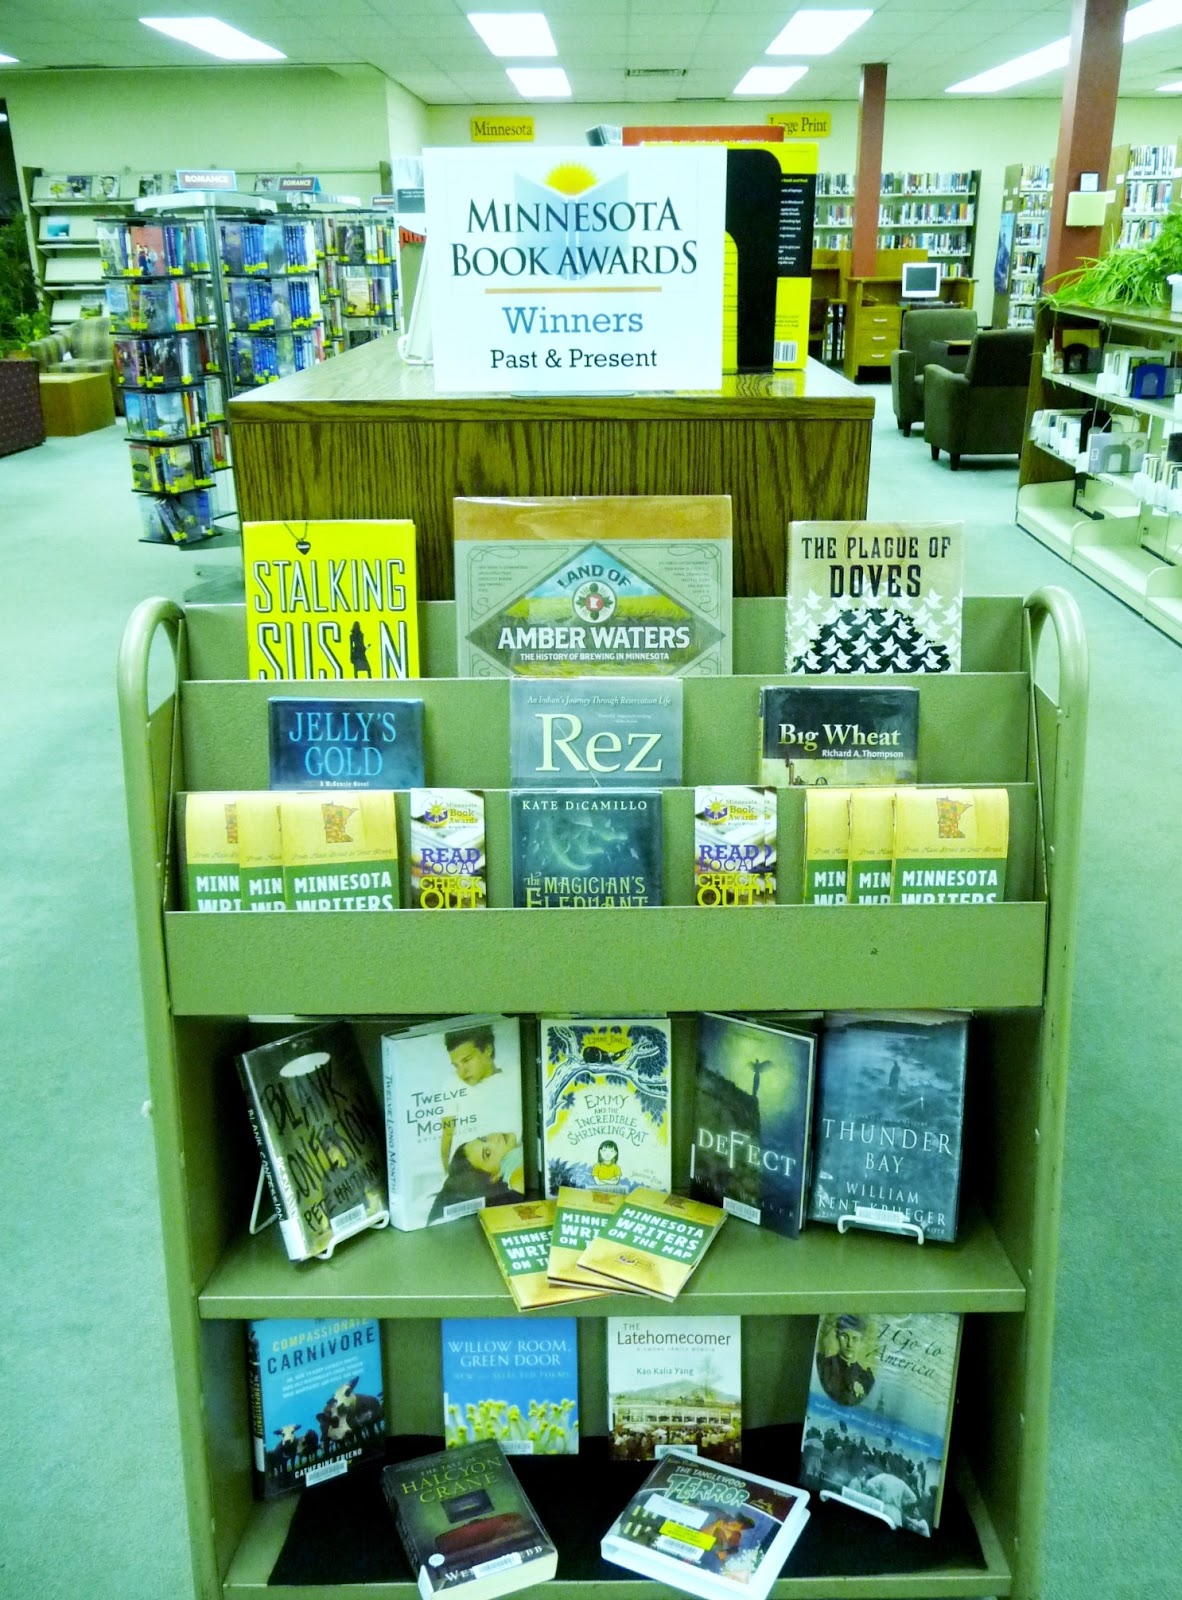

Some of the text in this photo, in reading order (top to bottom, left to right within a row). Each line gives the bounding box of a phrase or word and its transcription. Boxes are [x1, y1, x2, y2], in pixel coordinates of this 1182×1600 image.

[474, 121, 532, 136] Minnesota
[801, 117, 827, 131] Print
[184, 174, 228, 183] ROMANCE
[282, 179, 311, 187] ROMANCE
[466, 196, 682, 233] MINNESOTA
[450, 240, 698, 277] BOOK AWARDS
[502, 306, 643, 334] Winners
[490, 349, 657, 368] Past & Present
[802, 536, 951, 559] THE PLAGUE OF
[253, 558, 407, 613] STALKING
[557, 565, 632, 588] LAND OF
[830, 564, 921, 598] DOVES
[498, 626, 690, 650] AMBER WATERS
[527, 696, 671, 707] An Indian's Journey Through Reservation Life
[289, 712, 397, 742] JELLY'S
[779, 723, 901, 751] Big Wheat
[535, 714, 662, 773] Rez
[822, 749, 851, 757] Richard
[862, 750, 903, 759] Thompson
[305, 746, 383, 777] GOLD
[450, 808, 475, 817] Book
[522, 801, 558, 810] KATE
[730, 805, 754, 814] Book
[421, 848, 481, 862] READ
[699, 844, 760, 859] READ
[421, 861, 480, 875] LOCAL
[699, 858, 759, 872] LOCAL
[294, 871, 392, 894] MINNESOTA
[420, 876, 482, 891] CHECK
[544, 876, 645, 894] MAGICIAN'S
[697, 873, 760, 887] CHECK
[902, 870, 998, 887] MINNESOTA
[420, 889, 482, 910] OUT
[697, 886, 760, 907] OUT
[261, 1063, 347, 1136] BLANK
[411, 1087, 468, 1108] TWELVE
[584, 1094, 629, 1110] EMMY
[407, 1106, 444, 1124] LONG
[417, 1114, 477, 1137] MONTHS
[575, 1114, 638, 1129] INCREDIBLE
[247, 1109, 263, 1146] BLANK
[567, 1126, 649, 1147] SHRINKING RAT
[823, 1118, 952, 1154] THUNDER
[866, 1152, 903, 1174] BAY
[846, 1182, 919, 1204] WILLIAM
[303, 1193, 335, 1233] PETE
[818, 1195, 860, 1213] KENT
[562, 1213, 608, 1227] MINNE
[622, 1208, 705, 1239] MINNESOTA
[559, 1236, 578, 1246] ON
[608, 1228, 693, 1260] ON THE MAP
[615, 1218, 700, 1252] WRITERS
[512, 1260, 532, 1270] ON
[273, 1318, 368, 1352] COMPASSIONATE
[623, 1323, 640, 1331] THE
[448, 1340, 513, 1353] WILLOW
[617, 1330, 731, 1346] Latehomecomer
[890, 1328, 920, 1351] Go
[925, 1339, 943, 1357] to
[267, 1326, 375, 1375] CARNIVORE
[460, 1354, 561, 1367] GREEN DOOR
[636, 1366, 694, 1377] Kao Kalia Yang
[866, 1344, 936, 1379] America
[402, 1456, 503, 1495] HALCYON
[675, 1465, 746, 1489] THE TANGLEWOOD
[419, 1472, 499, 1503] CRANE
[667, 1473, 751, 1508] TERROR
